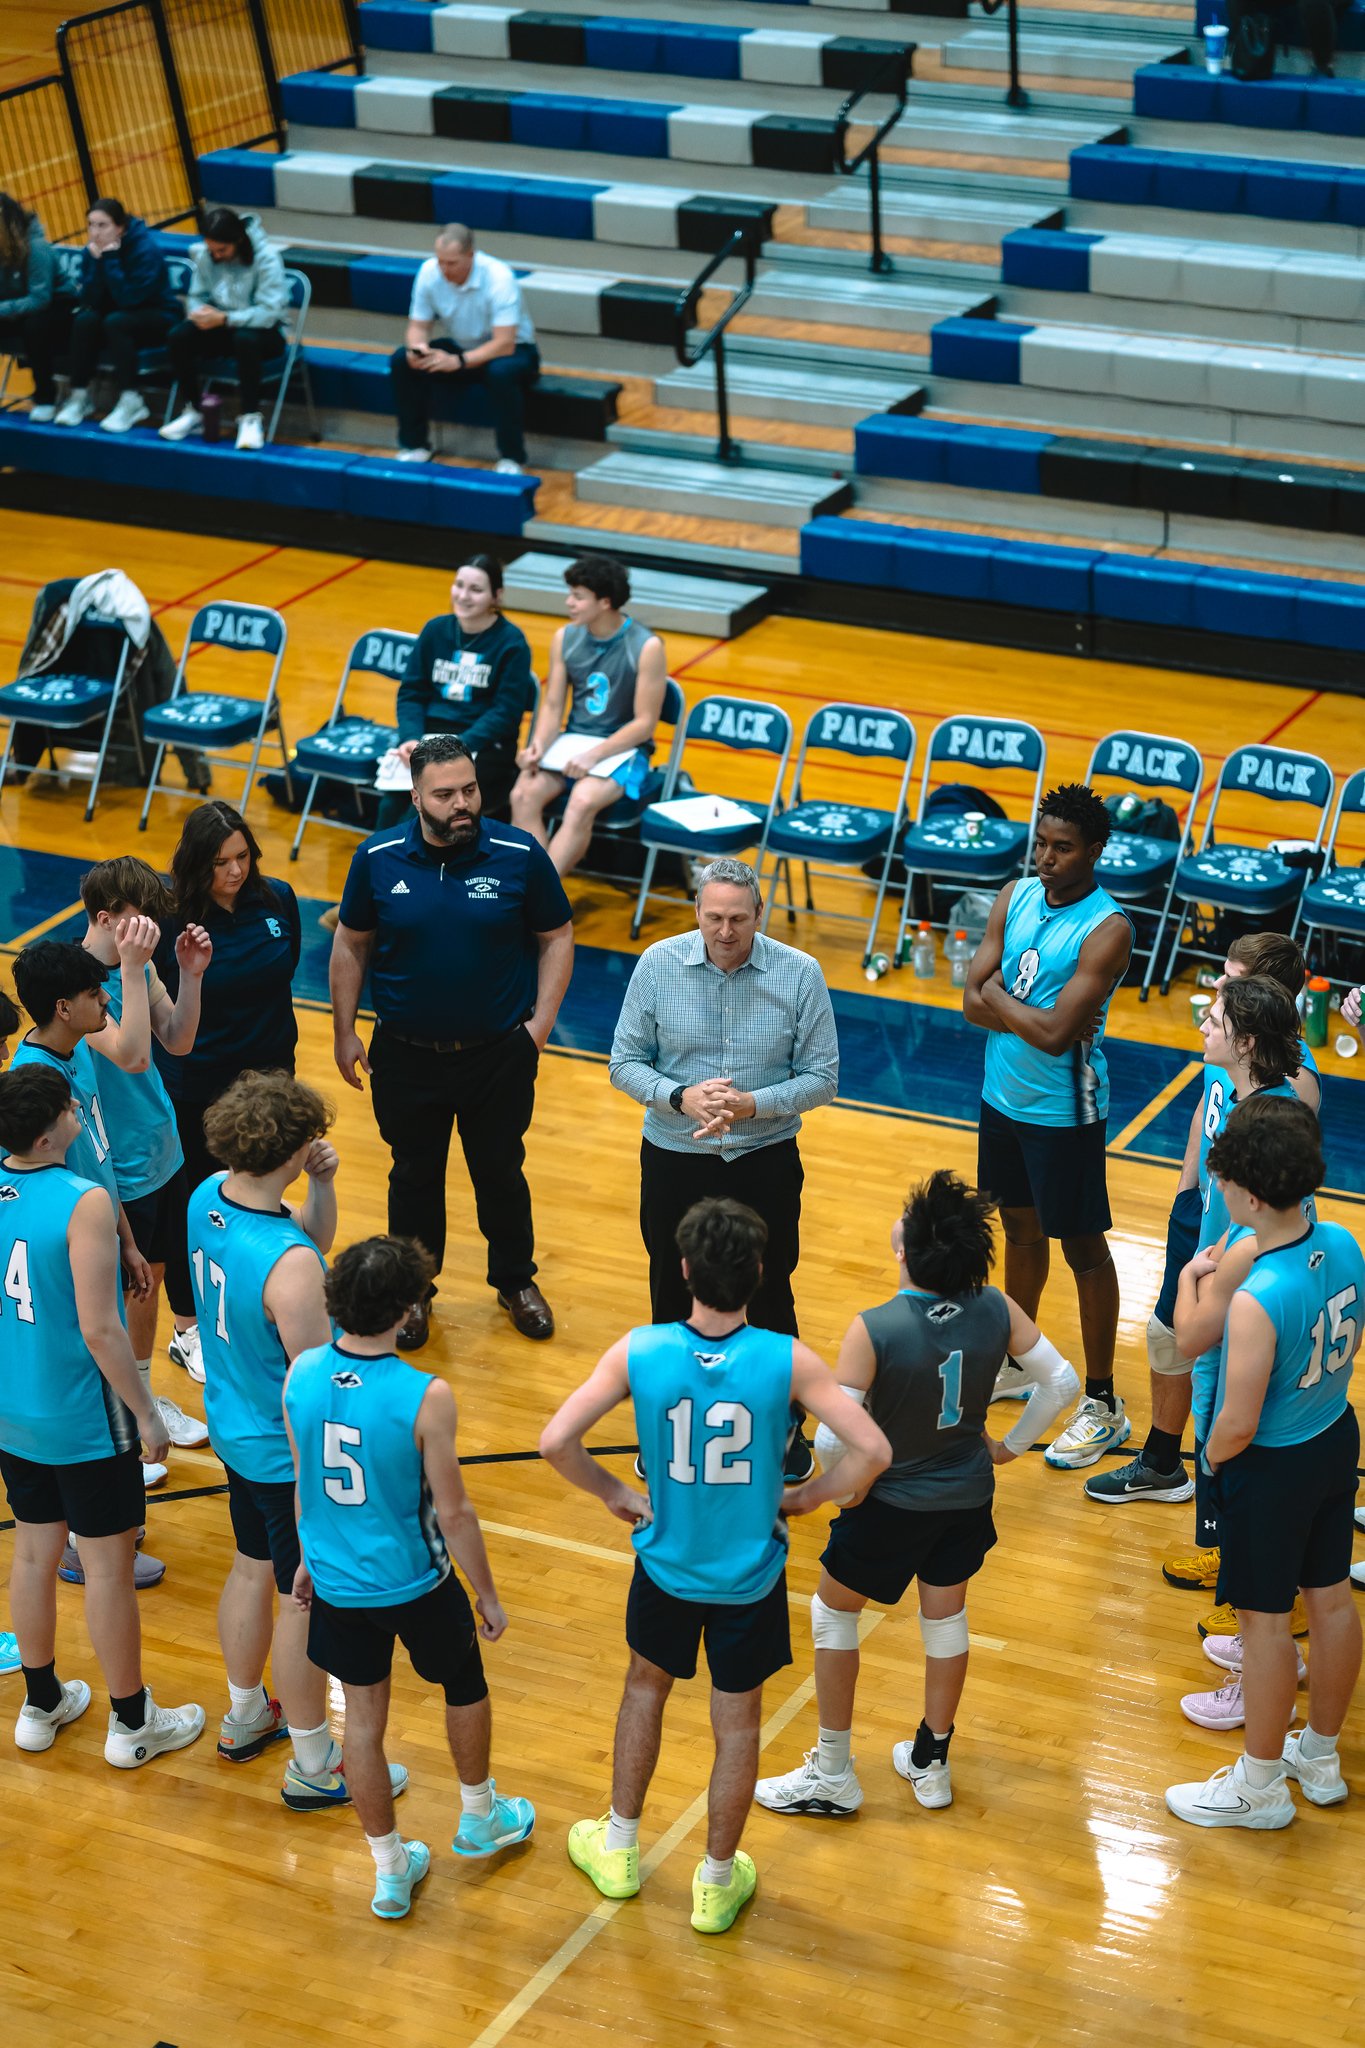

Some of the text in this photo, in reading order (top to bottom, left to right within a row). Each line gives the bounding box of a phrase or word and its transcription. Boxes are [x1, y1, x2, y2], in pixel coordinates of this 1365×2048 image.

[203, 609, 271, 647] PACK
[362, 636, 414, 673] PAC
[585, 671, 610, 716] 3
[701, 702, 775, 743] PACK
[820, 711, 898, 750] PACK
[947, 725, 1027, 762] PACK
[1107, 740, 1186, 782] PACK
[1237, 754, 1316, 797] PACK
[1011, 947, 1040, 1001] 8
[1205, 1079, 1225, 1142] 6
[0, 1238, 36, 1325] 4
[192, 1247, 231, 1346] 17
[1296, 1283, 1358, 1390] 15
[937, 1349, 965, 1431] 1
[323, 1419, 368, 1507] 5
[666, 1397, 753, 1485] 12
